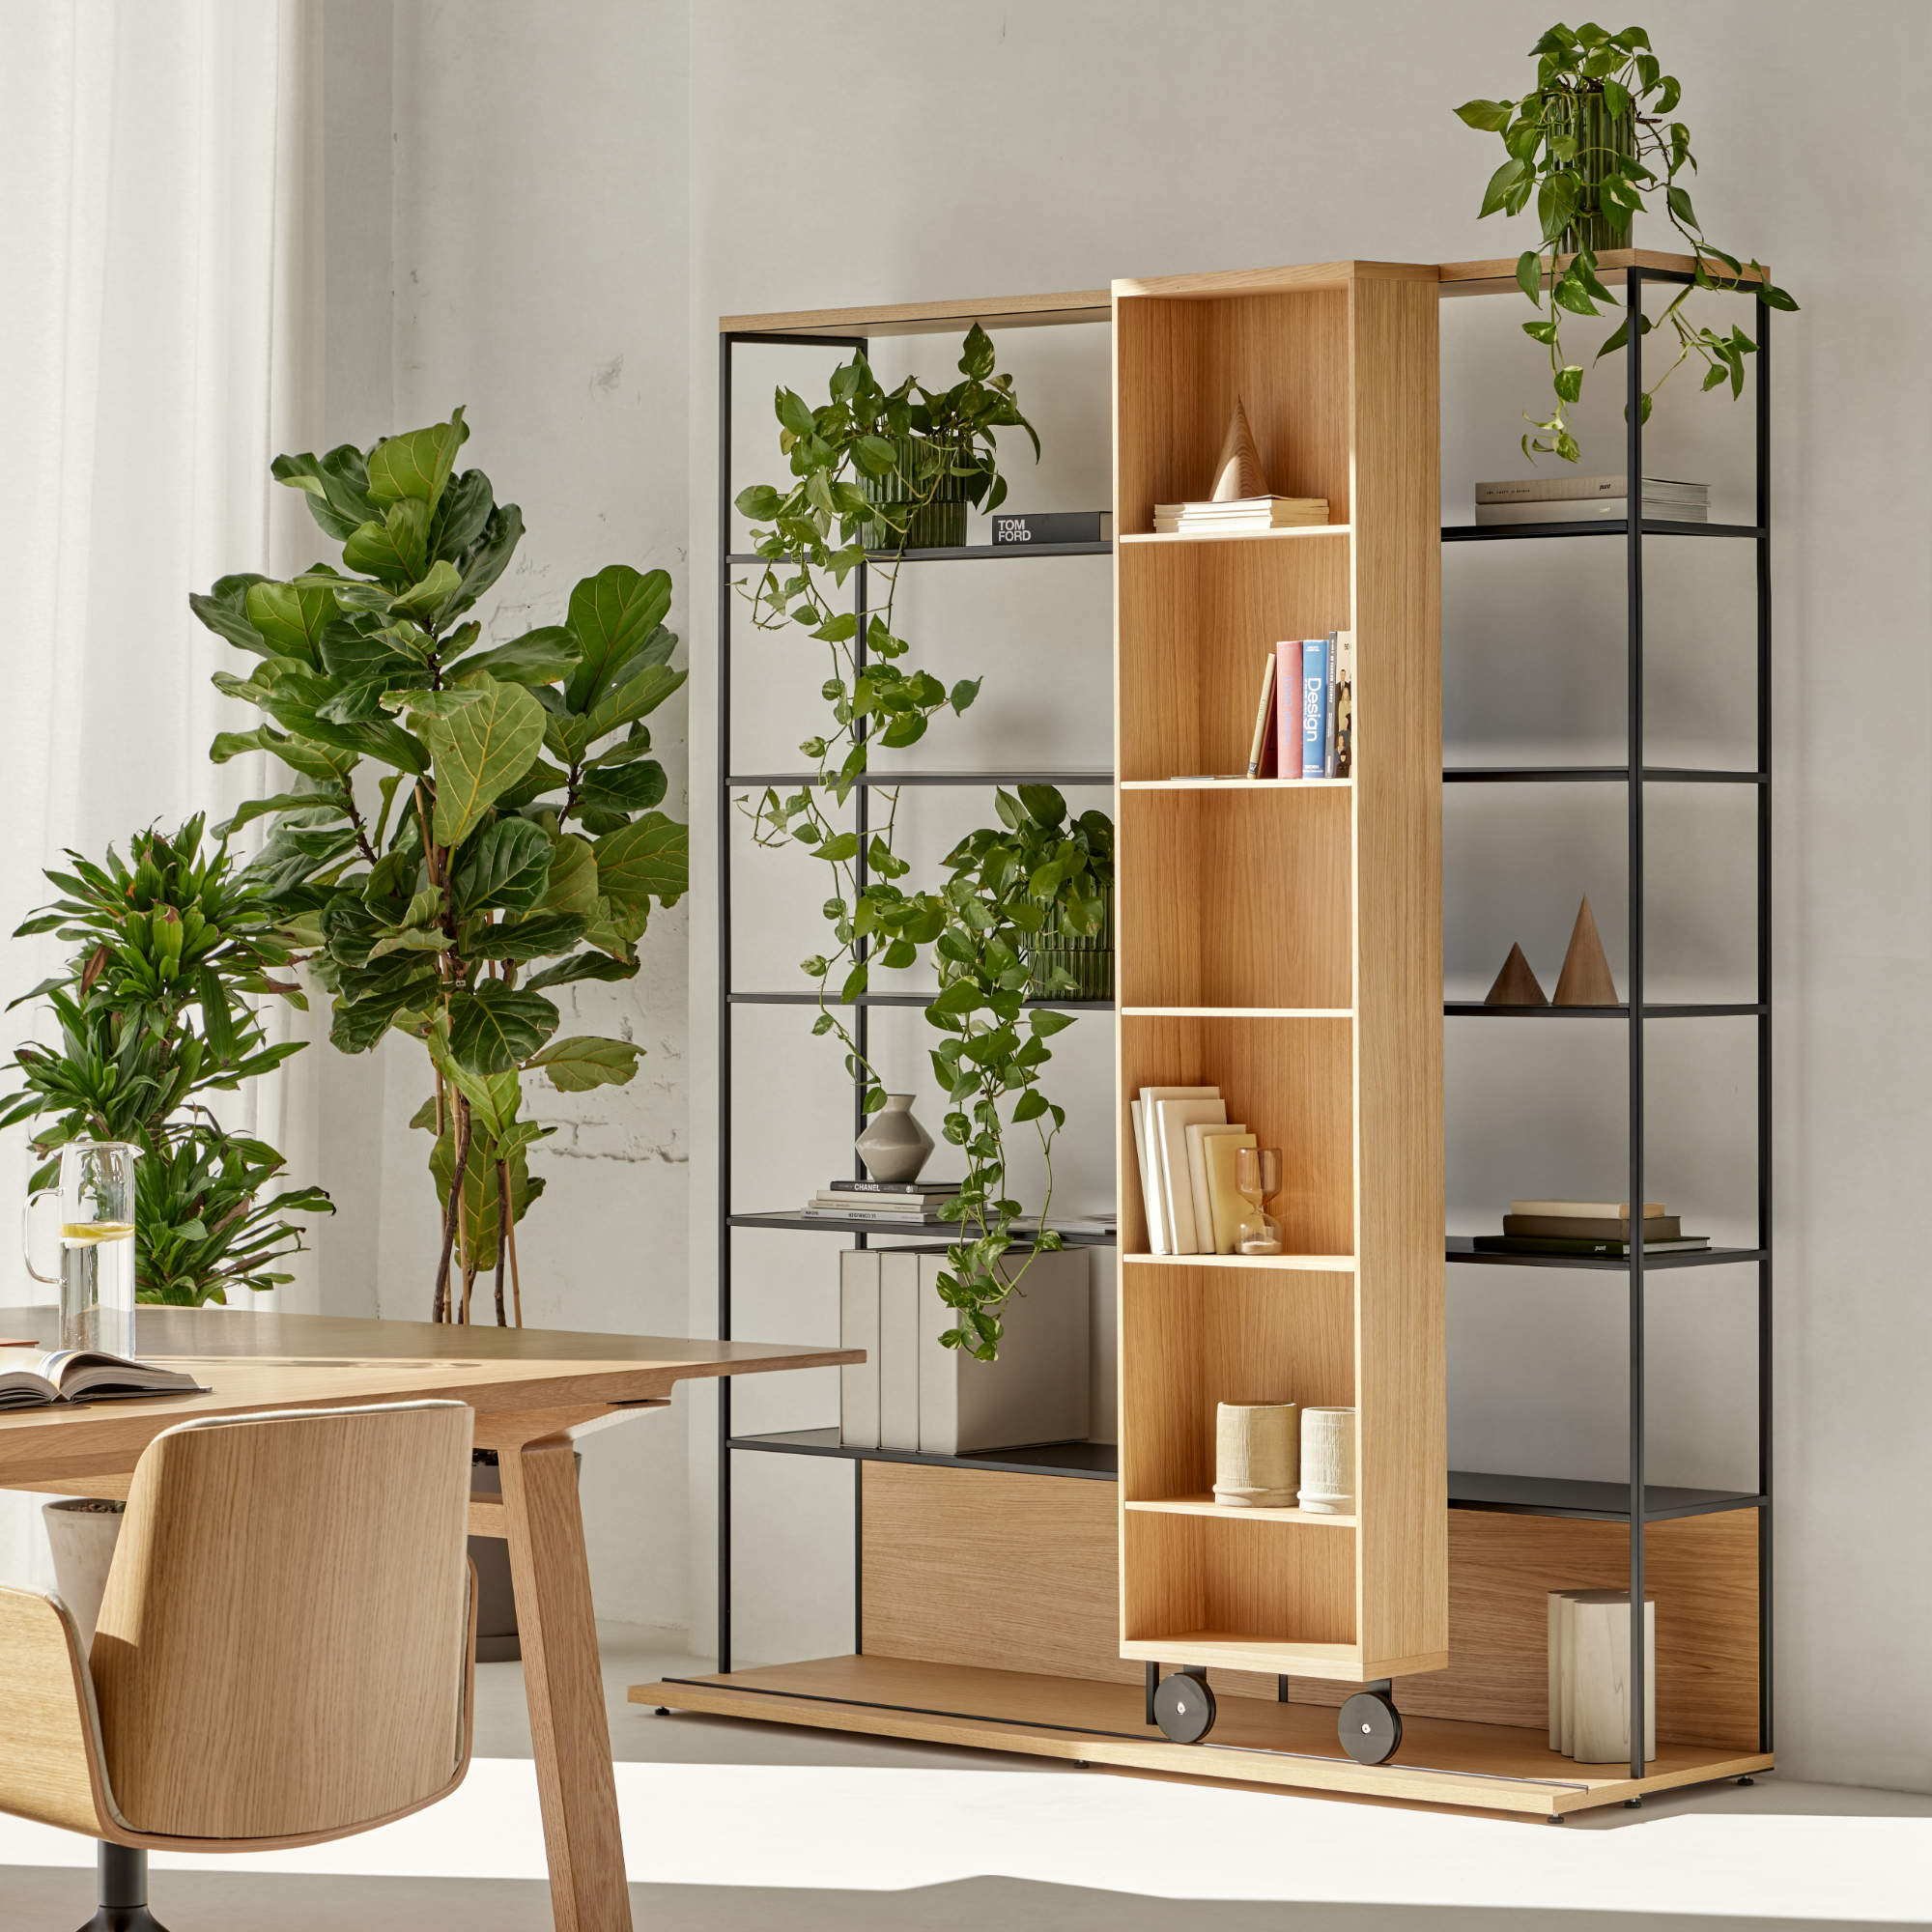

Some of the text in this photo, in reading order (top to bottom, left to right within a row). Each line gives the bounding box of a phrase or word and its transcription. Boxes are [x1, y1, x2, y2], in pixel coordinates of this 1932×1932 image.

[998, 520, 1025, 530] TOM
[999, 530, 1032, 542] FORD
[1303, 677, 1321, 742] Design
[854, 1183, 881, 1192] CHANEL
